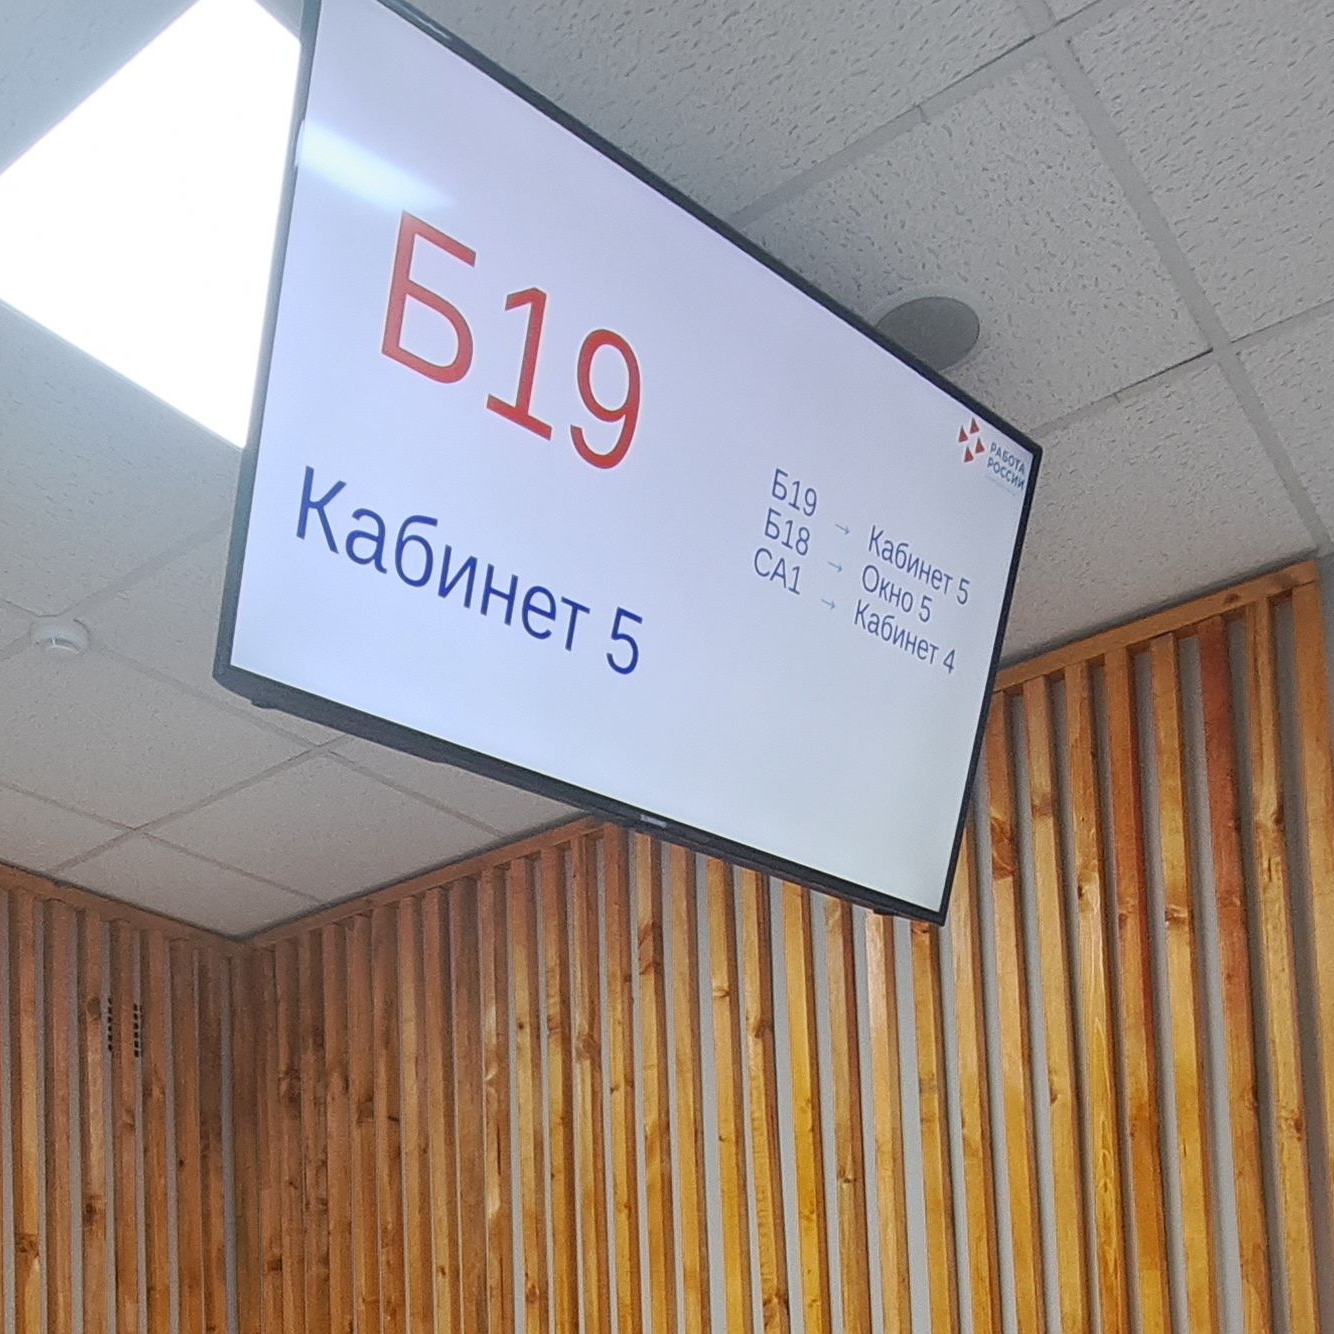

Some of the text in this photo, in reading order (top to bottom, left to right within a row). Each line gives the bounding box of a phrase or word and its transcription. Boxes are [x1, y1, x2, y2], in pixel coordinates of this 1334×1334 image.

[381, 211, 642, 470] Б19
[987, 457, 1025, 490] РОССИИ
[990, 441, 1026, 474] РАБОТА
[296, 466, 643, 675] Кабинет 5
[764, 507, 933, 623] Б18 Окно 5
[771, 468, 971, 605] Б19 Кабинет 5
[753, 547, 957, 675] СА1 Кабинет 4
